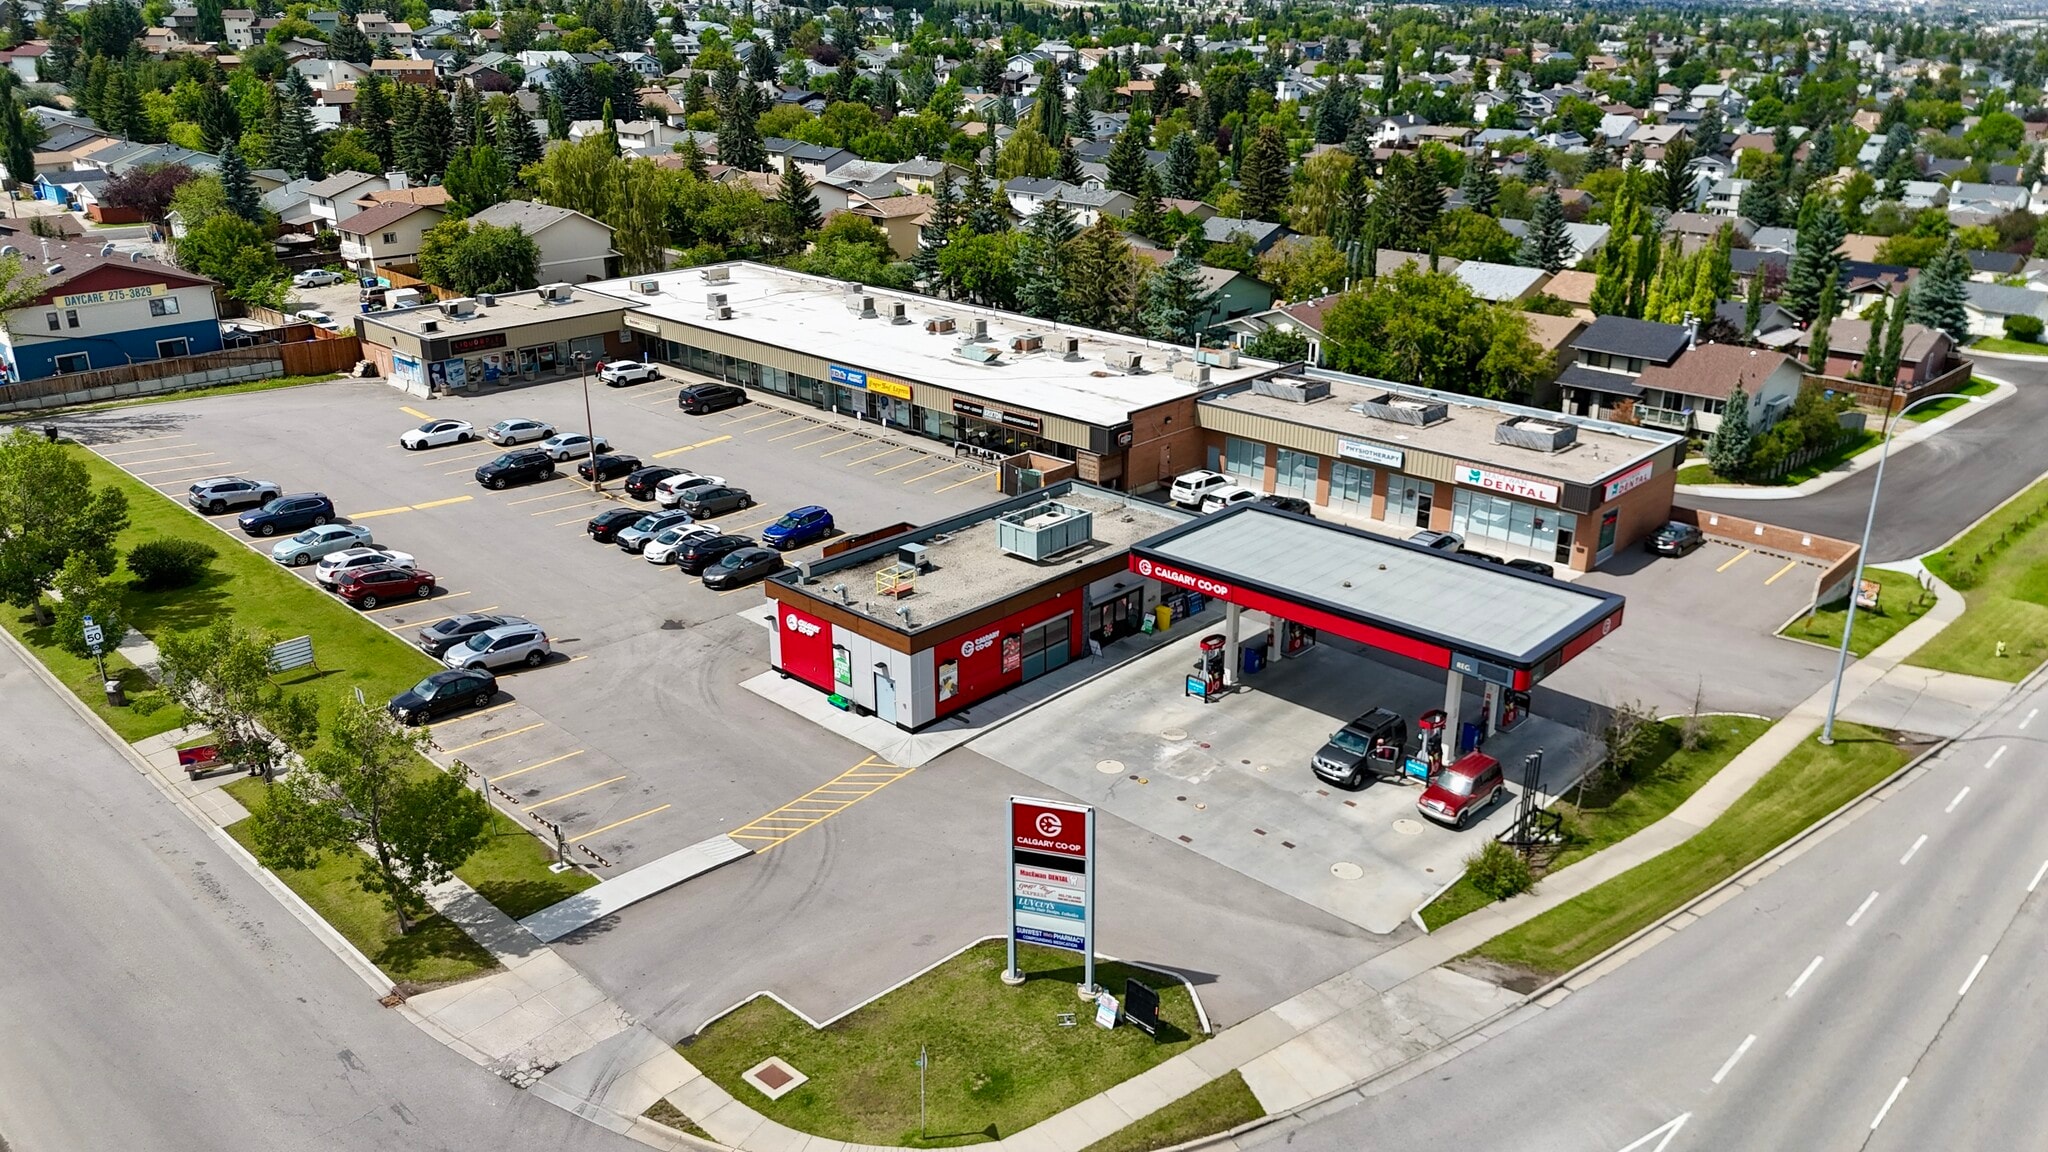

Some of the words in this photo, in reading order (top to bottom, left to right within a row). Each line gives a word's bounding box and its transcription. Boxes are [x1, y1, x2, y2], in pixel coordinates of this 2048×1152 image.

[64, 293, 105, 307] DAYCARE
[108, 287, 152, 301] 275-3829
[1346, 445, 1400, 462] PHYSIOTHERAPY
[1483, 478, 1547, 500] DENTAL
[1154, 566, 1197, 586] CALGARY
[1197, 579, 1229, 595] CO-OP
[87, 632, 102, 643] 50
[1017, 836, 1054, 848] CALGARY
[1020, 869, 1047, 879] MacEwan
[1048, 874, 1068, 883] DENTAL
[1016, 927, 1043, 937] SUNWEST
[1053, 933, 1084, 944] PHARMACY
